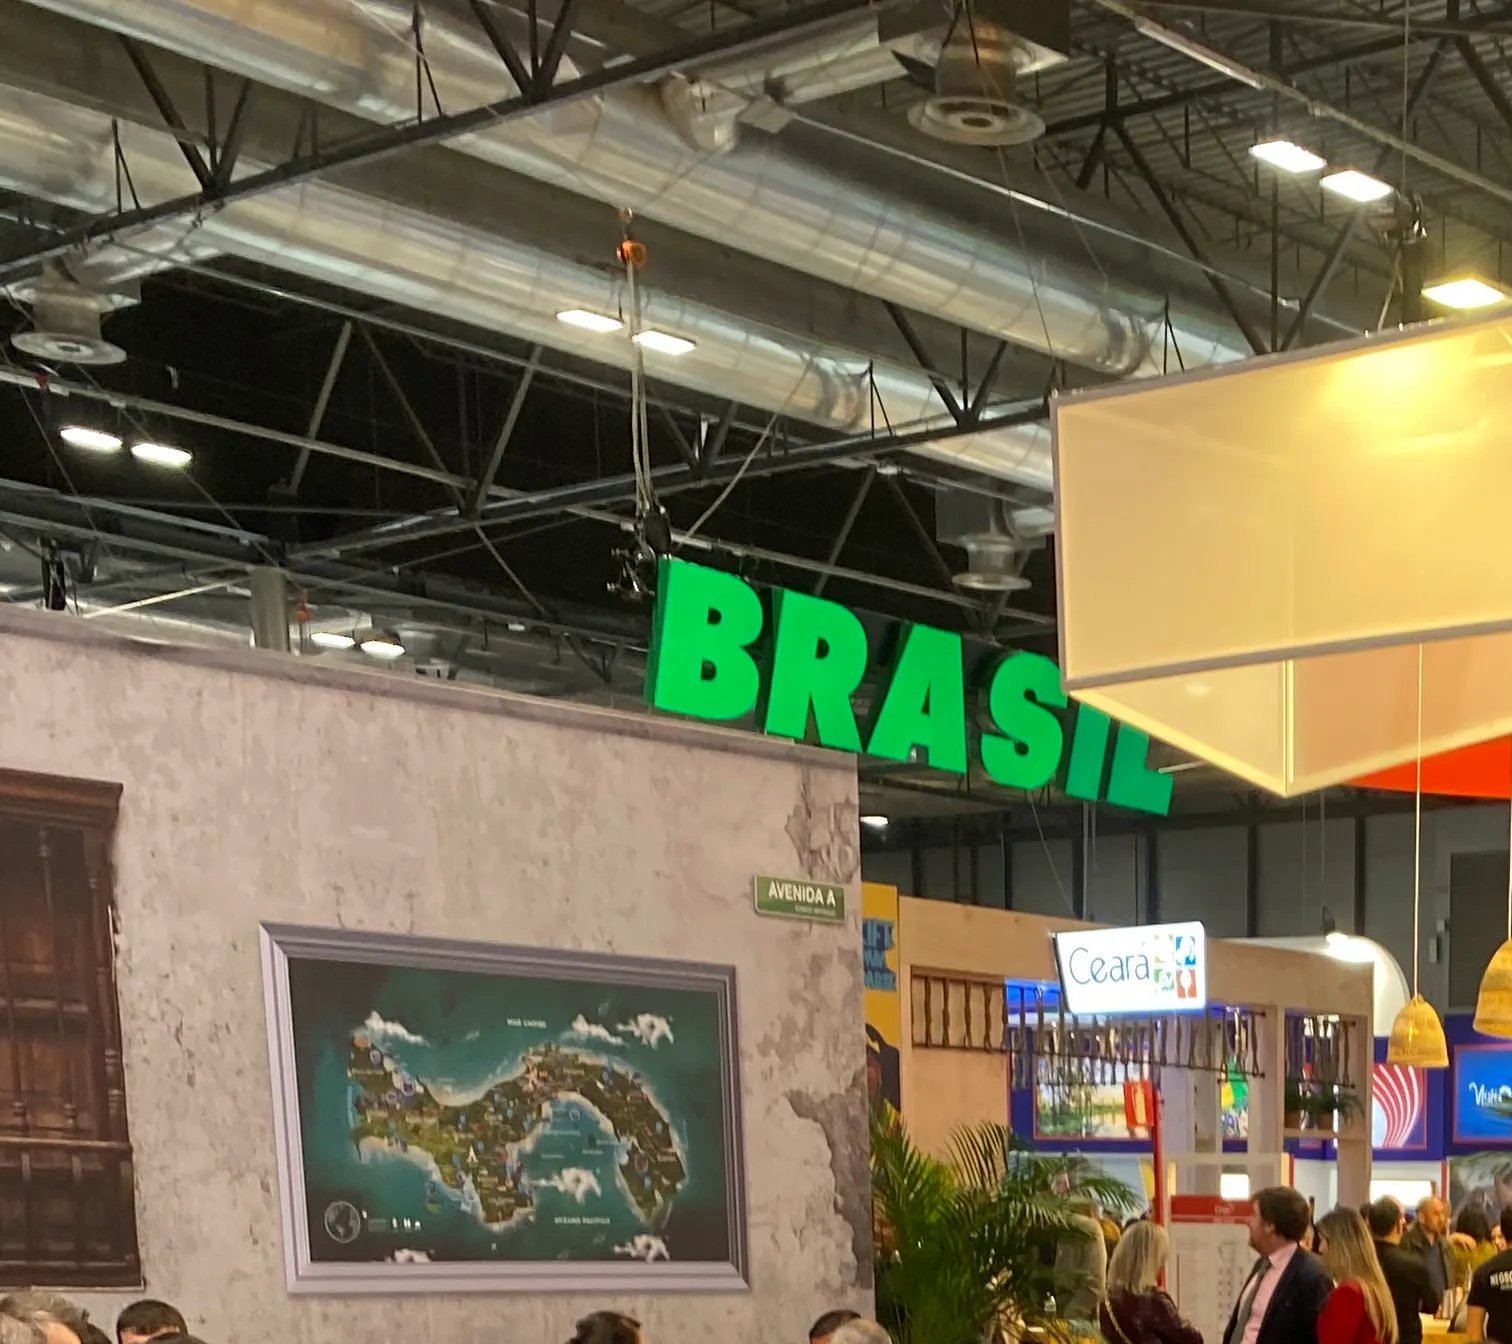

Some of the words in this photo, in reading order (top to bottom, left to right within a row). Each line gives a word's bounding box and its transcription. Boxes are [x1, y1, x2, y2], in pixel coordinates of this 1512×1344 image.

[648, 554, 1174, 818] BRASIL
[768, 880, 825, 906] AVENIDA
[826, 888, 837, 908] A
